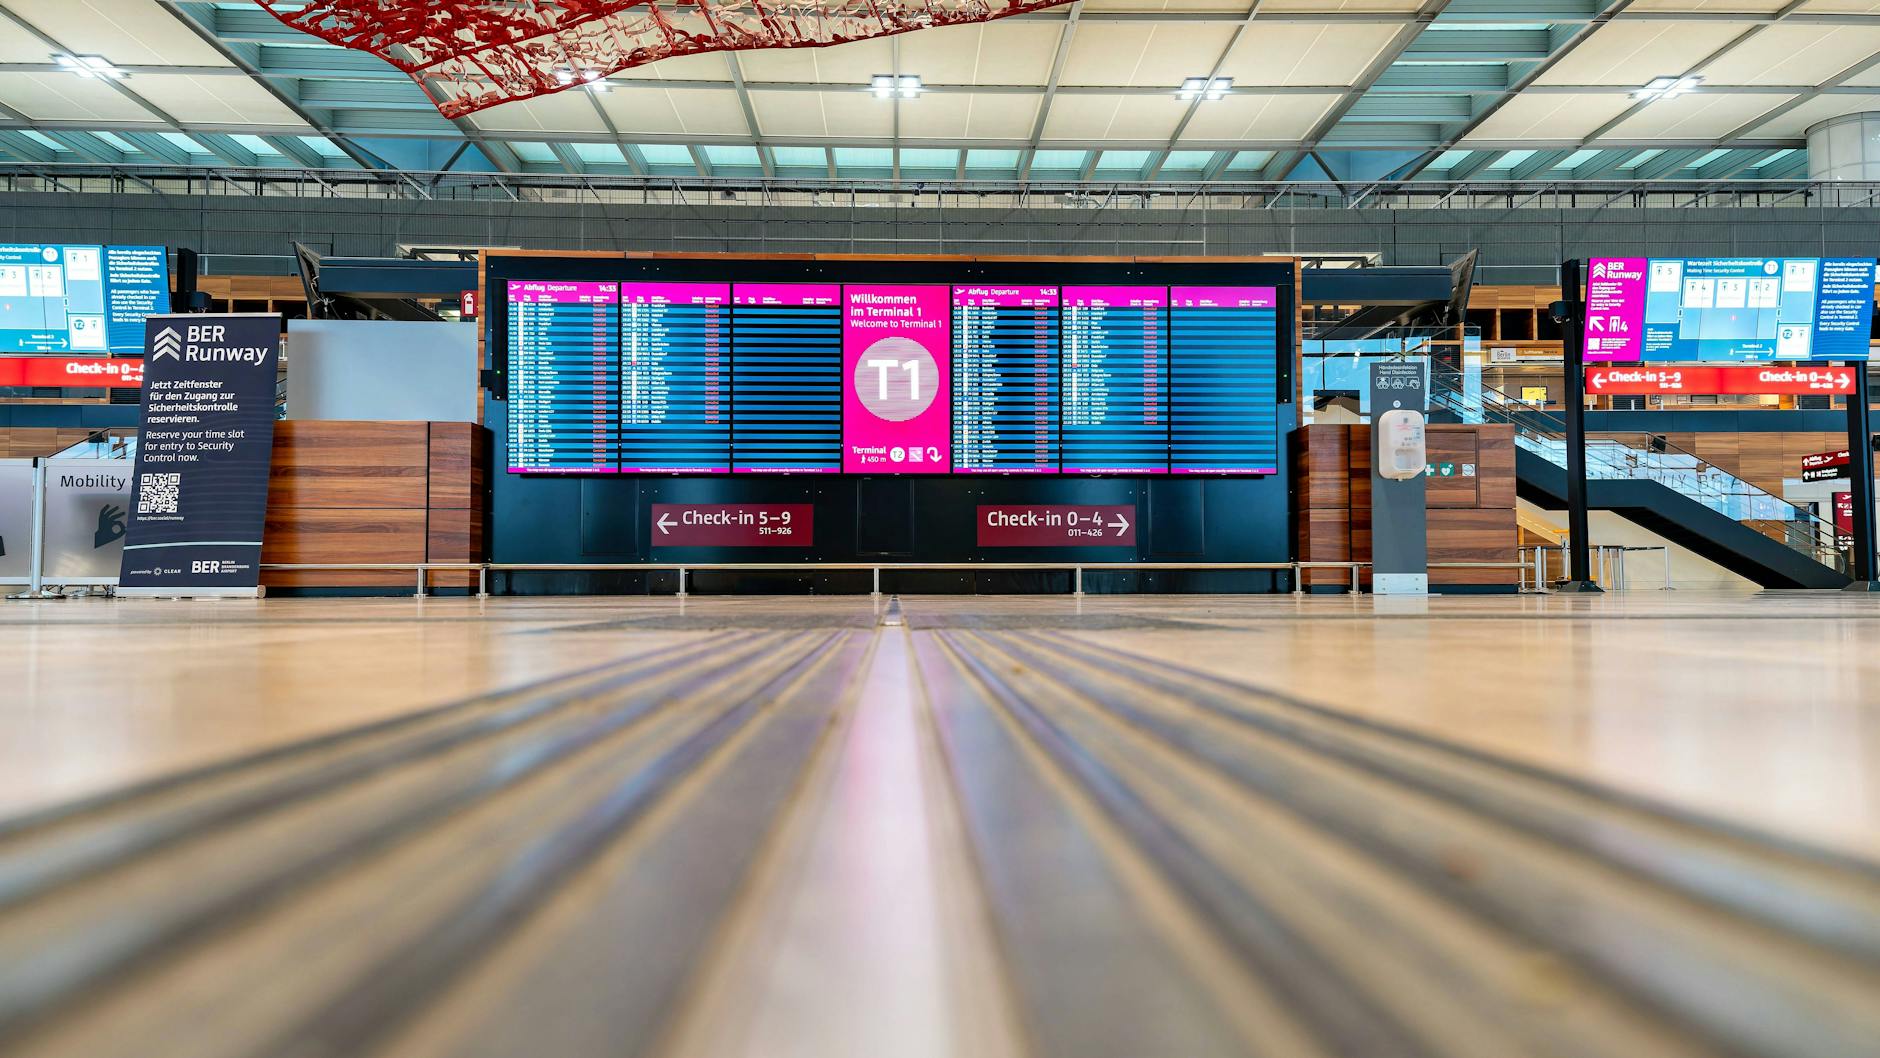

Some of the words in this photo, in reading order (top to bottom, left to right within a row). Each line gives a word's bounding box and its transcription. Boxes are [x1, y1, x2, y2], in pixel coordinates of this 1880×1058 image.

[1608, 262, 1624, 270] BER
[1607, 271, 1642, 280] Runway
[850, 294, 916, 304] Willkommen
[850, 306, 864, 316] im
[866, 306, 914, 316] Terminal
[917, 307, 922, 316] 1
[850, 320, 888, 328] Welcome
[890, 320, 898, 328] to
[900, 319, 936, 328] Terminal
[1620, 321, 1628, 332] 4
[187, 326, 226, 342] BER
[186, 345, 268, 366] Runway
[66, 363, 118, 374] Check-in
[868, 360, 920, 400] T1
[1608, 371, 1656, 382] Check-in
[1760, 370, 1808, 382] Check-in
[1809, 372, 1834, 382] 0–4
[150, 381, 172, 390] Jetzt
[174, 380, 223, 389] Zeitfenster
[149, 392, 164, 400] für
[165, 392, 182, 400] den
[184, 392, 218, 402] Zugang
[148, 403, 238, 412] Sicherheitskontrolle
[147, 415, 200, 424] reservieren.
[146, 431, 180, 439] Reserve
[182, 431, 203, 440] your
[205, 430, 226, 438] time
[228, 430, 244, 438] slot
[144, 442, 158, 451] for
[160, 443, 184, 452] entry
[186, 442, 196, 450] to
[198, 442, 234, 452] Security
[852, 446, 886, 454] Terminal
[144, 454, 176, 462] Control
[892, 450, 903, 458] T2
[60, 475, 126, 491] Mobility
[682, 510, 754, 525] Check-in
[759, 512, 791, 524] 5–9
[988, 511, 1061, 526] Check-in
[1067, 512, 1103, 526] 0–4
[192, 560, 220, 574] BER
